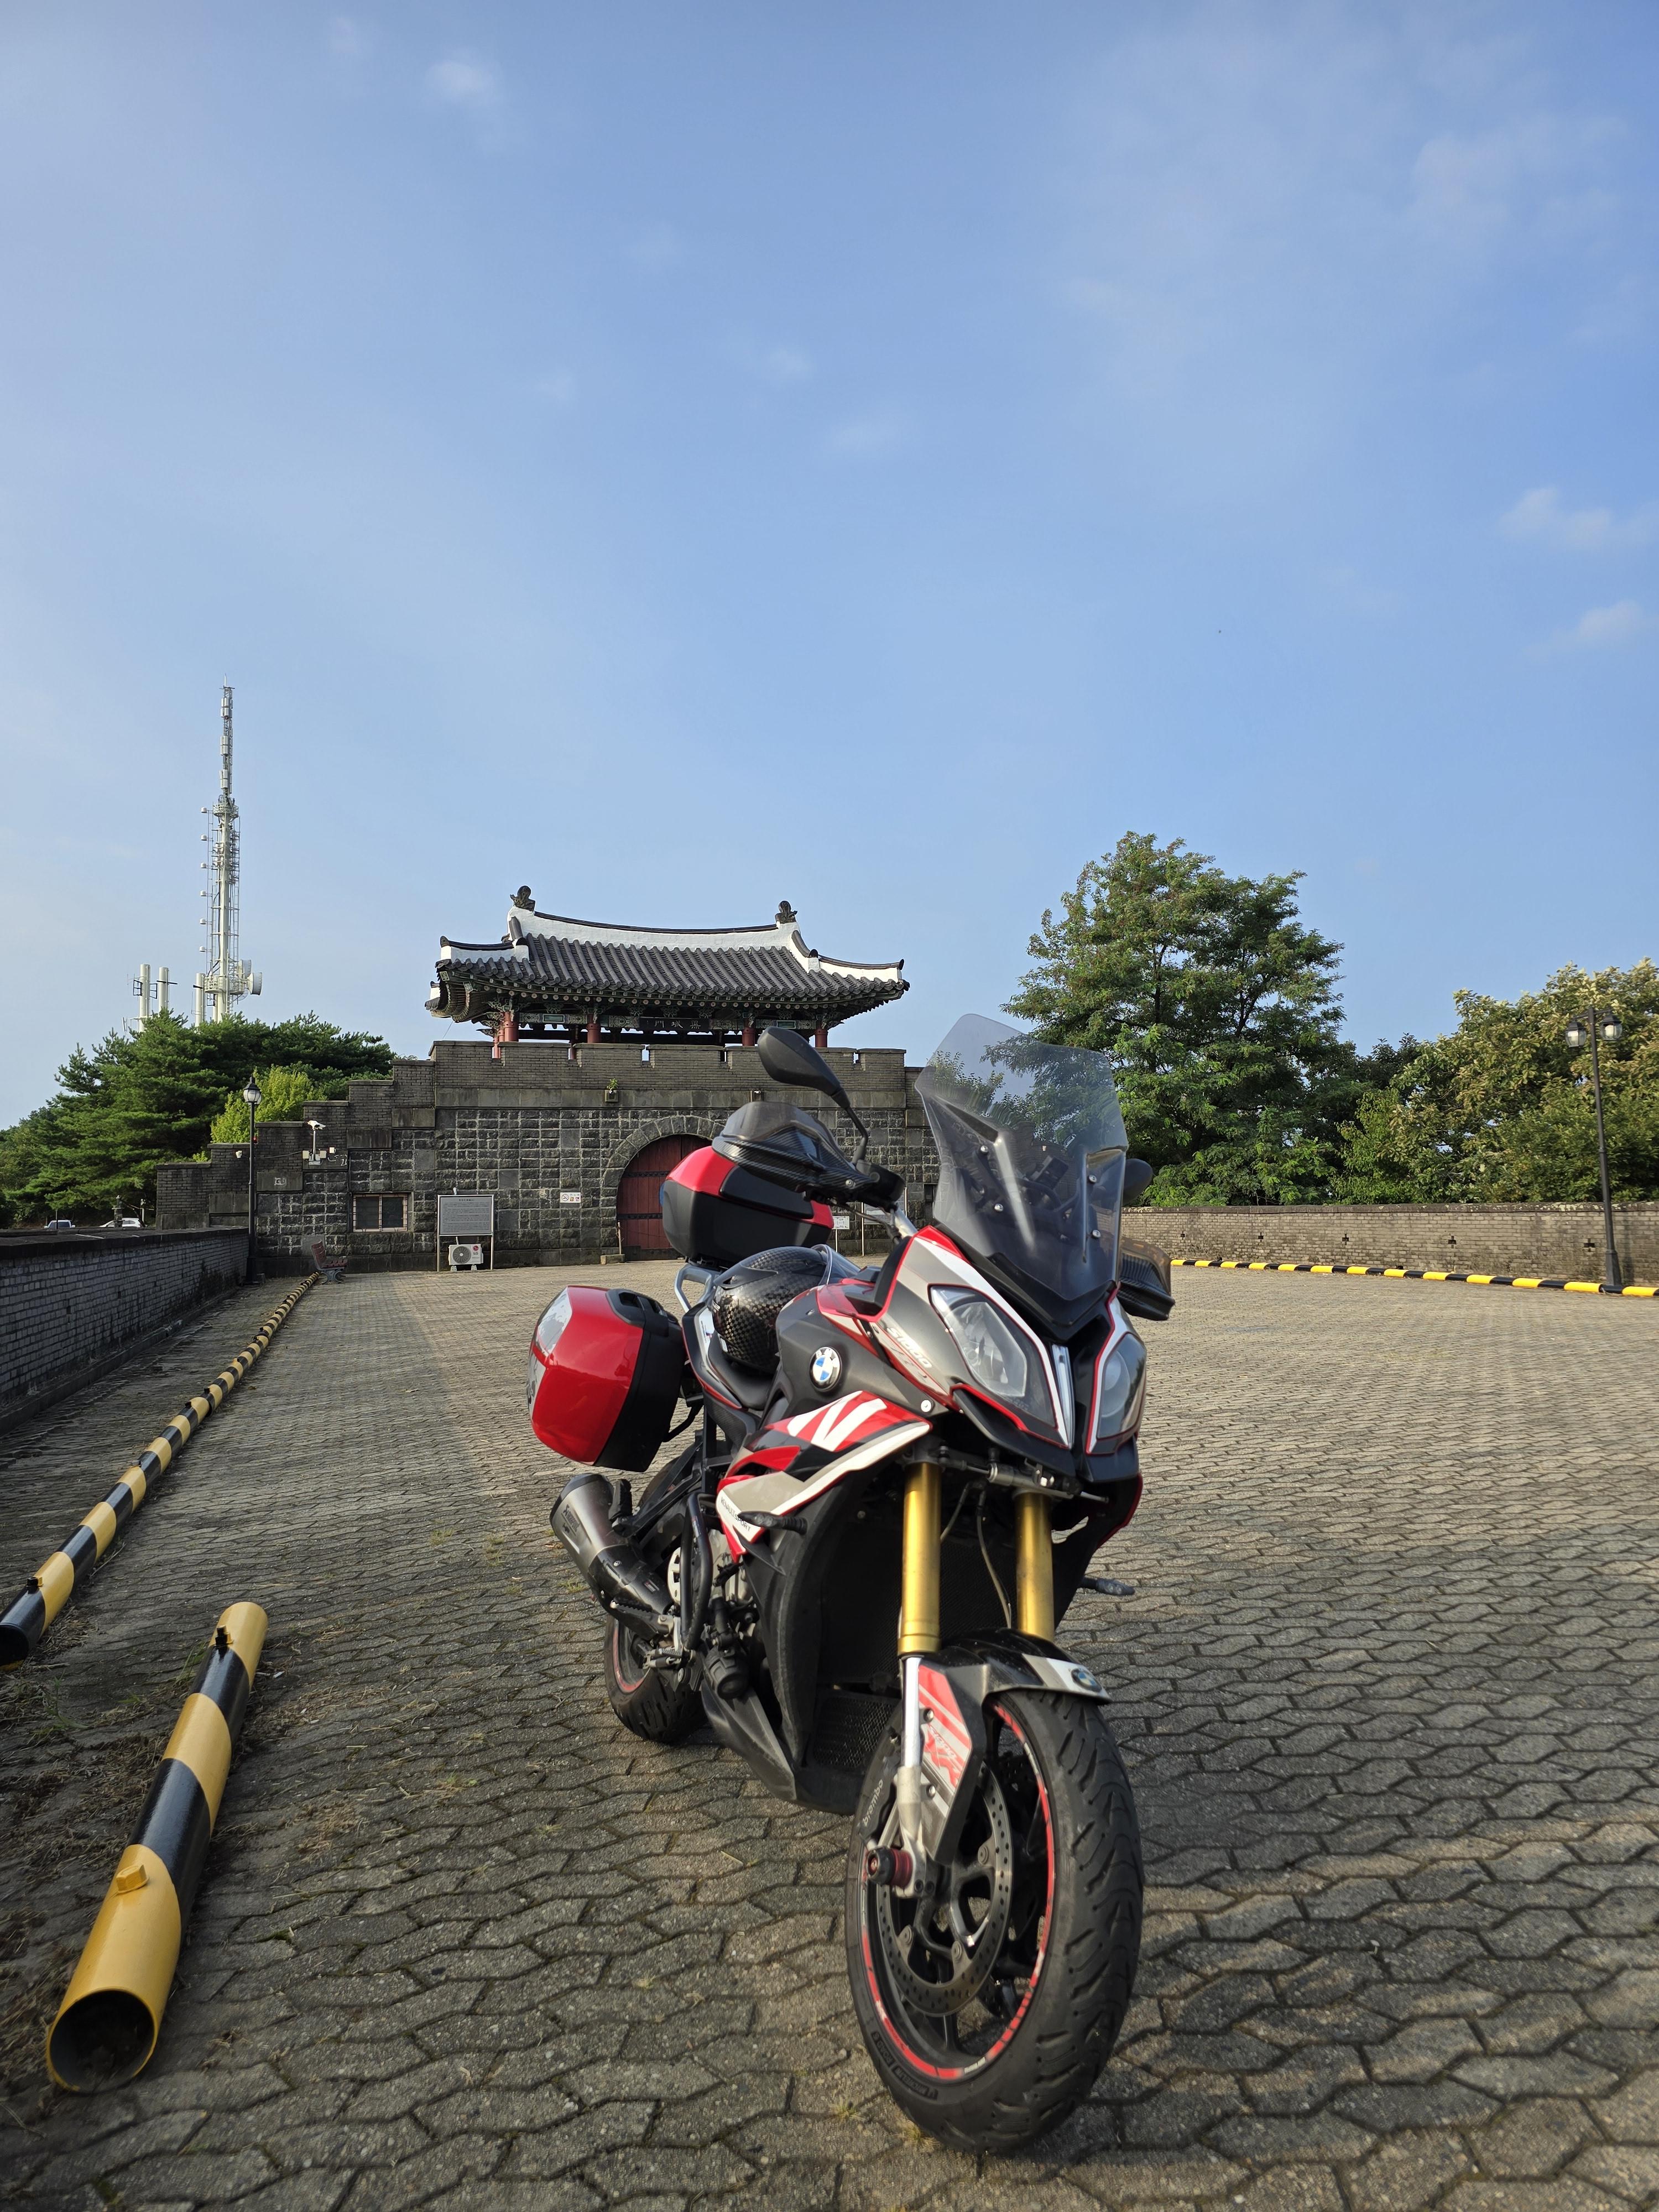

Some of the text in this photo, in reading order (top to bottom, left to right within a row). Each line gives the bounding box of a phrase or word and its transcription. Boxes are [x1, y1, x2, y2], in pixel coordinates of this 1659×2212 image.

[863, 1779, 883, 1827] brembo
[877, 2039, 894, 2063] ROAD
[895, 2067, 929, 2095] MICHELIN
